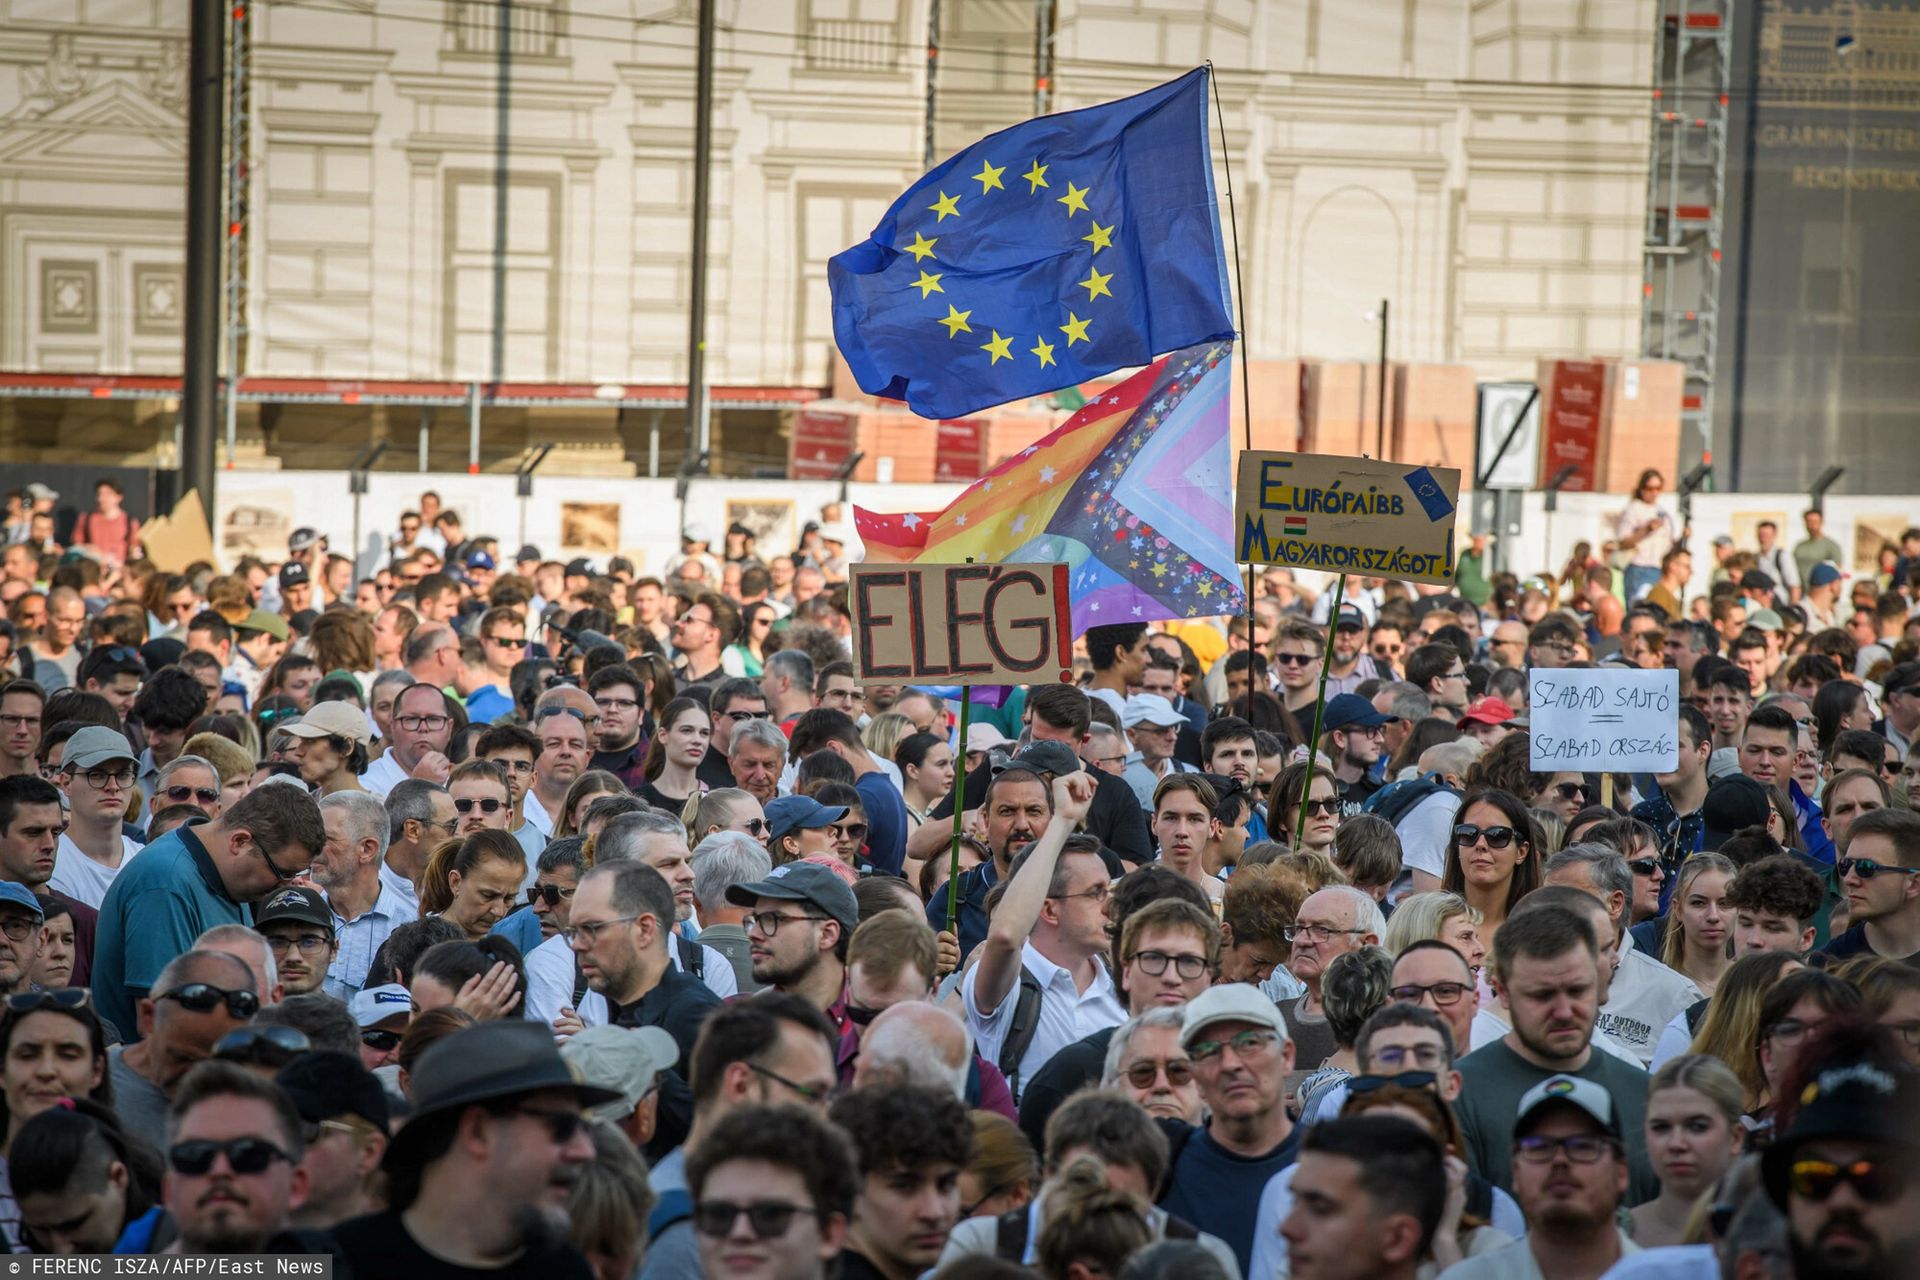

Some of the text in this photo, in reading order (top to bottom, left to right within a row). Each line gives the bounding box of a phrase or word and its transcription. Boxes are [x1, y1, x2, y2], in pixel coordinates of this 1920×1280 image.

[1241, 513, 1454, 577] MAGYARORSZÁGOT!
[856, 564, 1073, 683] ELÉG!
[1533, 680, 1670, 711] SZABAD SAJTÓ
[1534, 733, 1675, 759] SZABAD ORSZÁG
[1614, 1016, 1651, 1034] OUTDOOR
